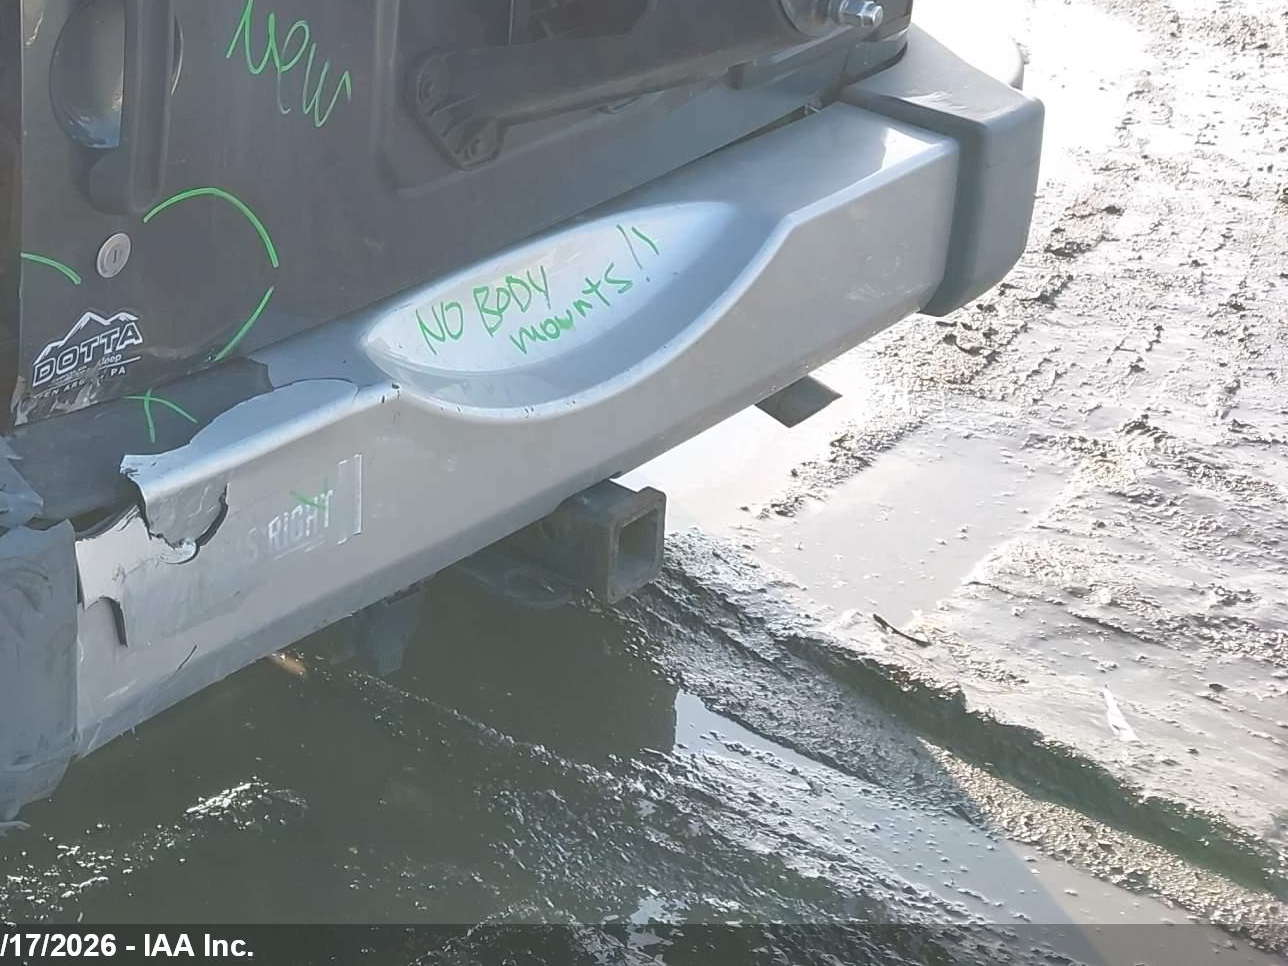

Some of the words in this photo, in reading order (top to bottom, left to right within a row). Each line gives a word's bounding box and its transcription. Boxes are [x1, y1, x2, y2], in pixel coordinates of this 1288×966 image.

[415, 301, 464, 355] NO
[473, 265, 551, 337] BODY
[33, 321, 143, 387] DOTTA
[110, 366, 126, 377] PA
